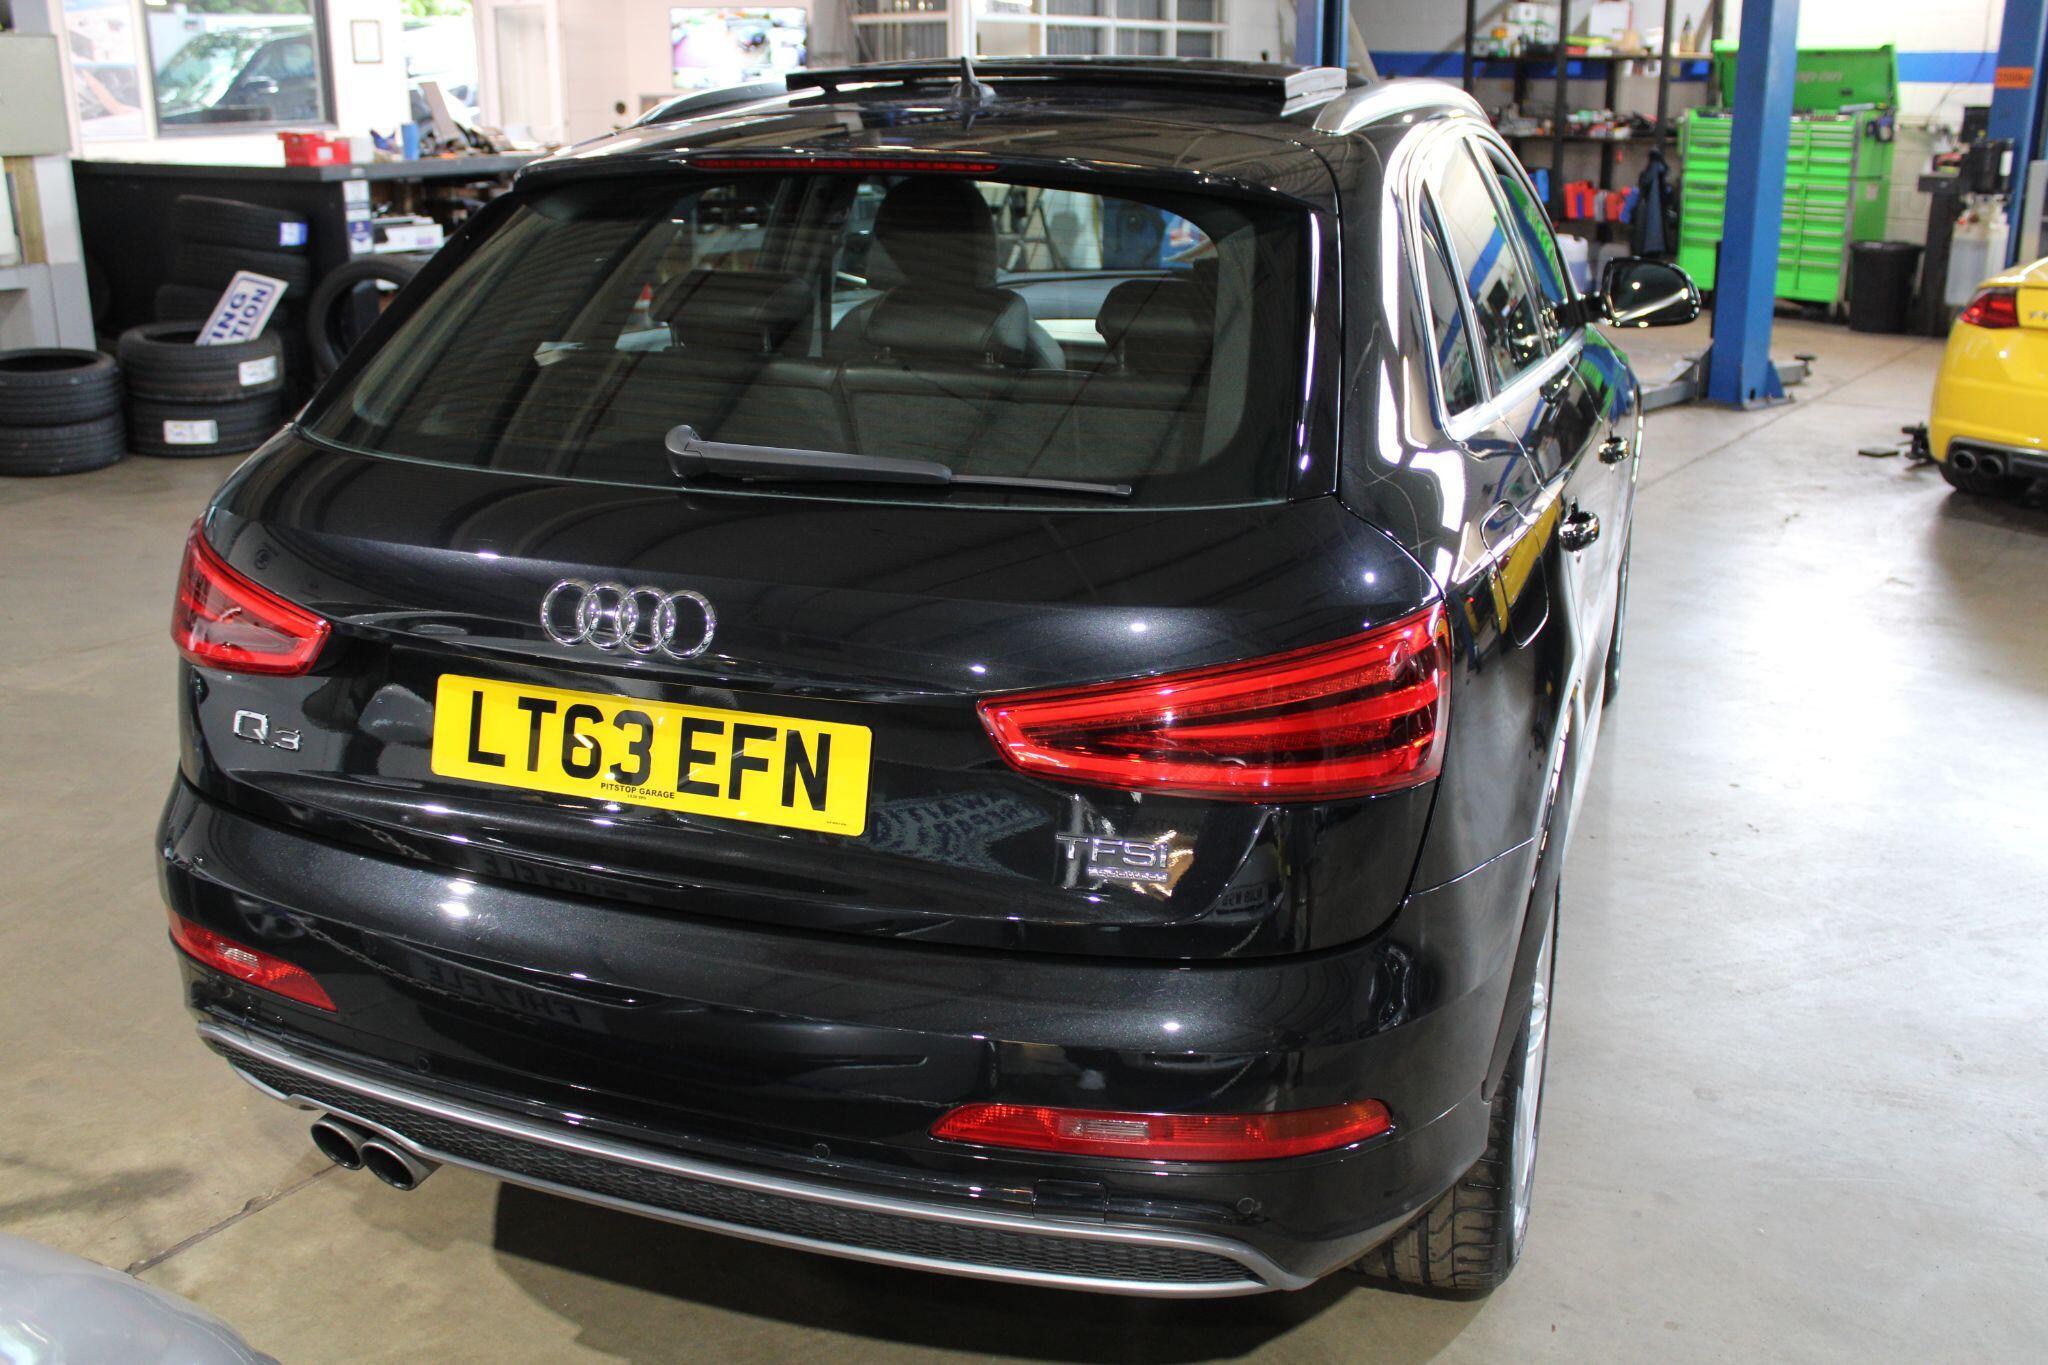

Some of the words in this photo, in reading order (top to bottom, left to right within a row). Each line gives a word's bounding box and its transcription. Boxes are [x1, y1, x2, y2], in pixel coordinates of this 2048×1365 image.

[233, 709, 302, 752] Q3
[467, 690, 654, 787] LT63
[676, 716, 832, 812] EFN
[600, 782, 637, 793] PITSTOP
[639, 788, 675, 799] GARAGE
